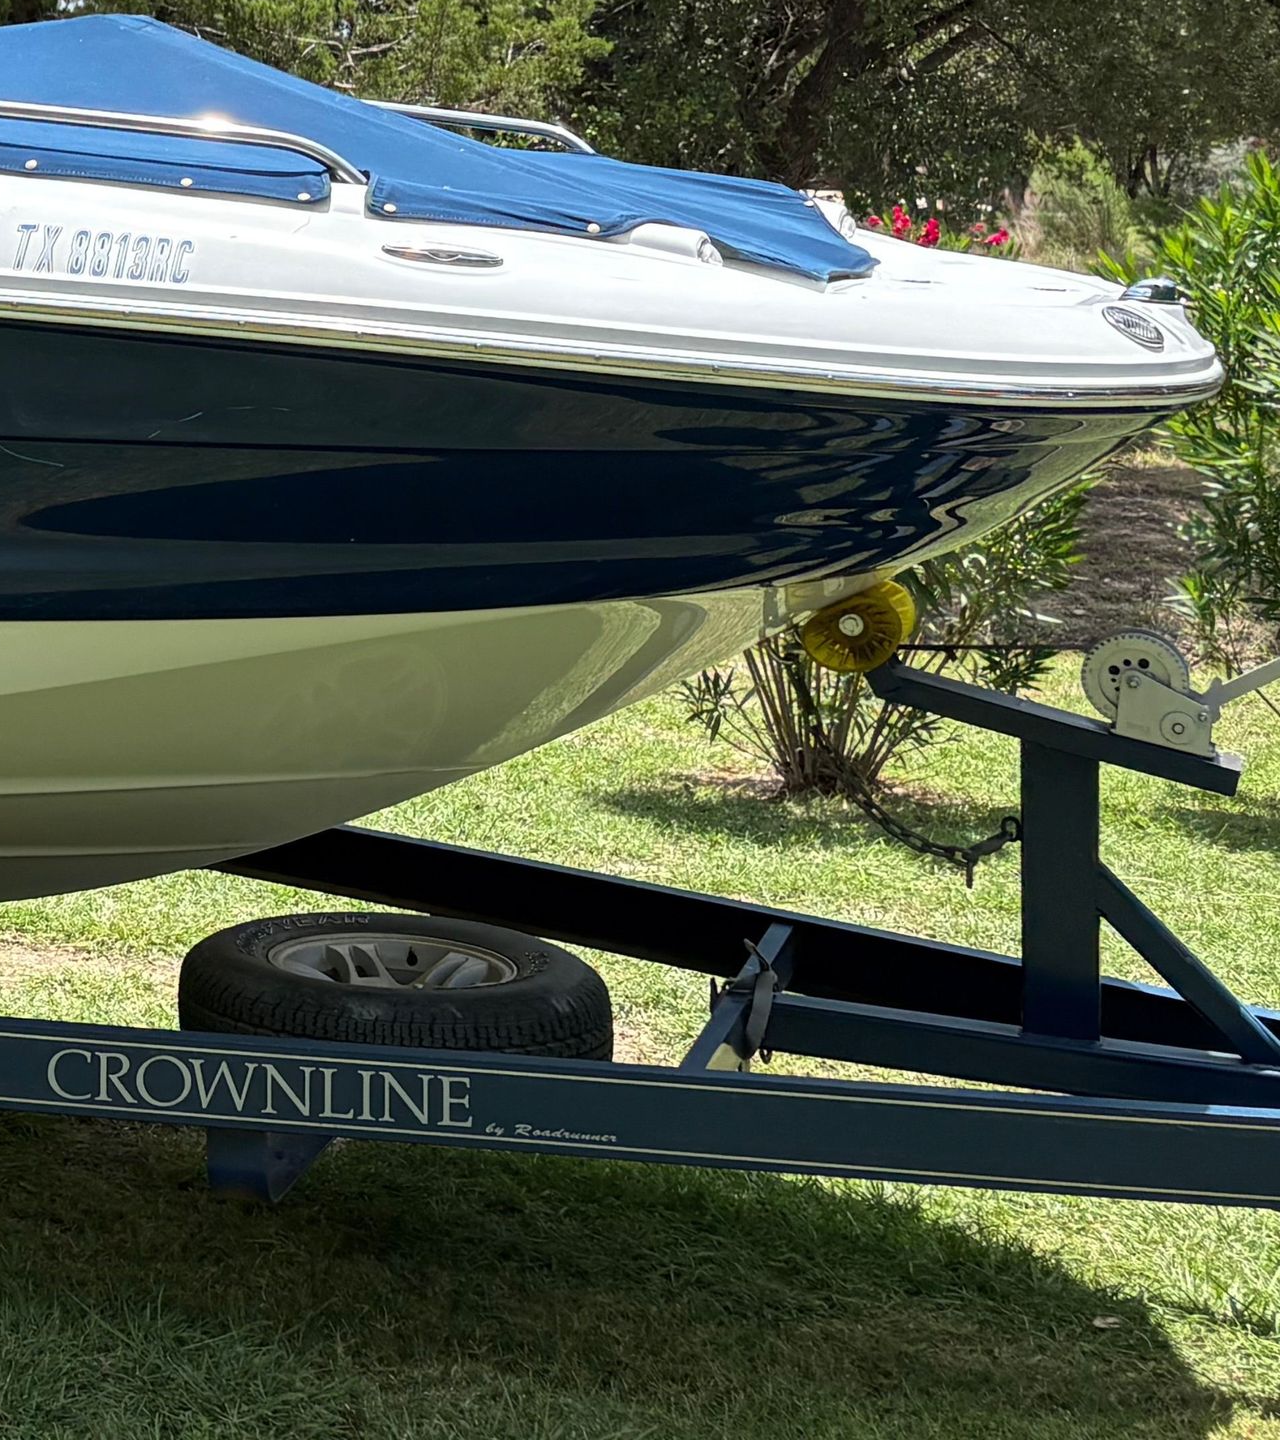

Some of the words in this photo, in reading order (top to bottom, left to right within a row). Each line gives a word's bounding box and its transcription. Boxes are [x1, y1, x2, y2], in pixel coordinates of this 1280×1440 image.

[12, 223, 64, 274] TX
[66, 229, 194, 284] 8813RC
[235, 914, 371, 956] YEAR
[47, 1048, 473, 1128] CROWNLINE
[485, 1122, 505, 1137] by
[514, 1123, 617, 1142] Roadrunner
